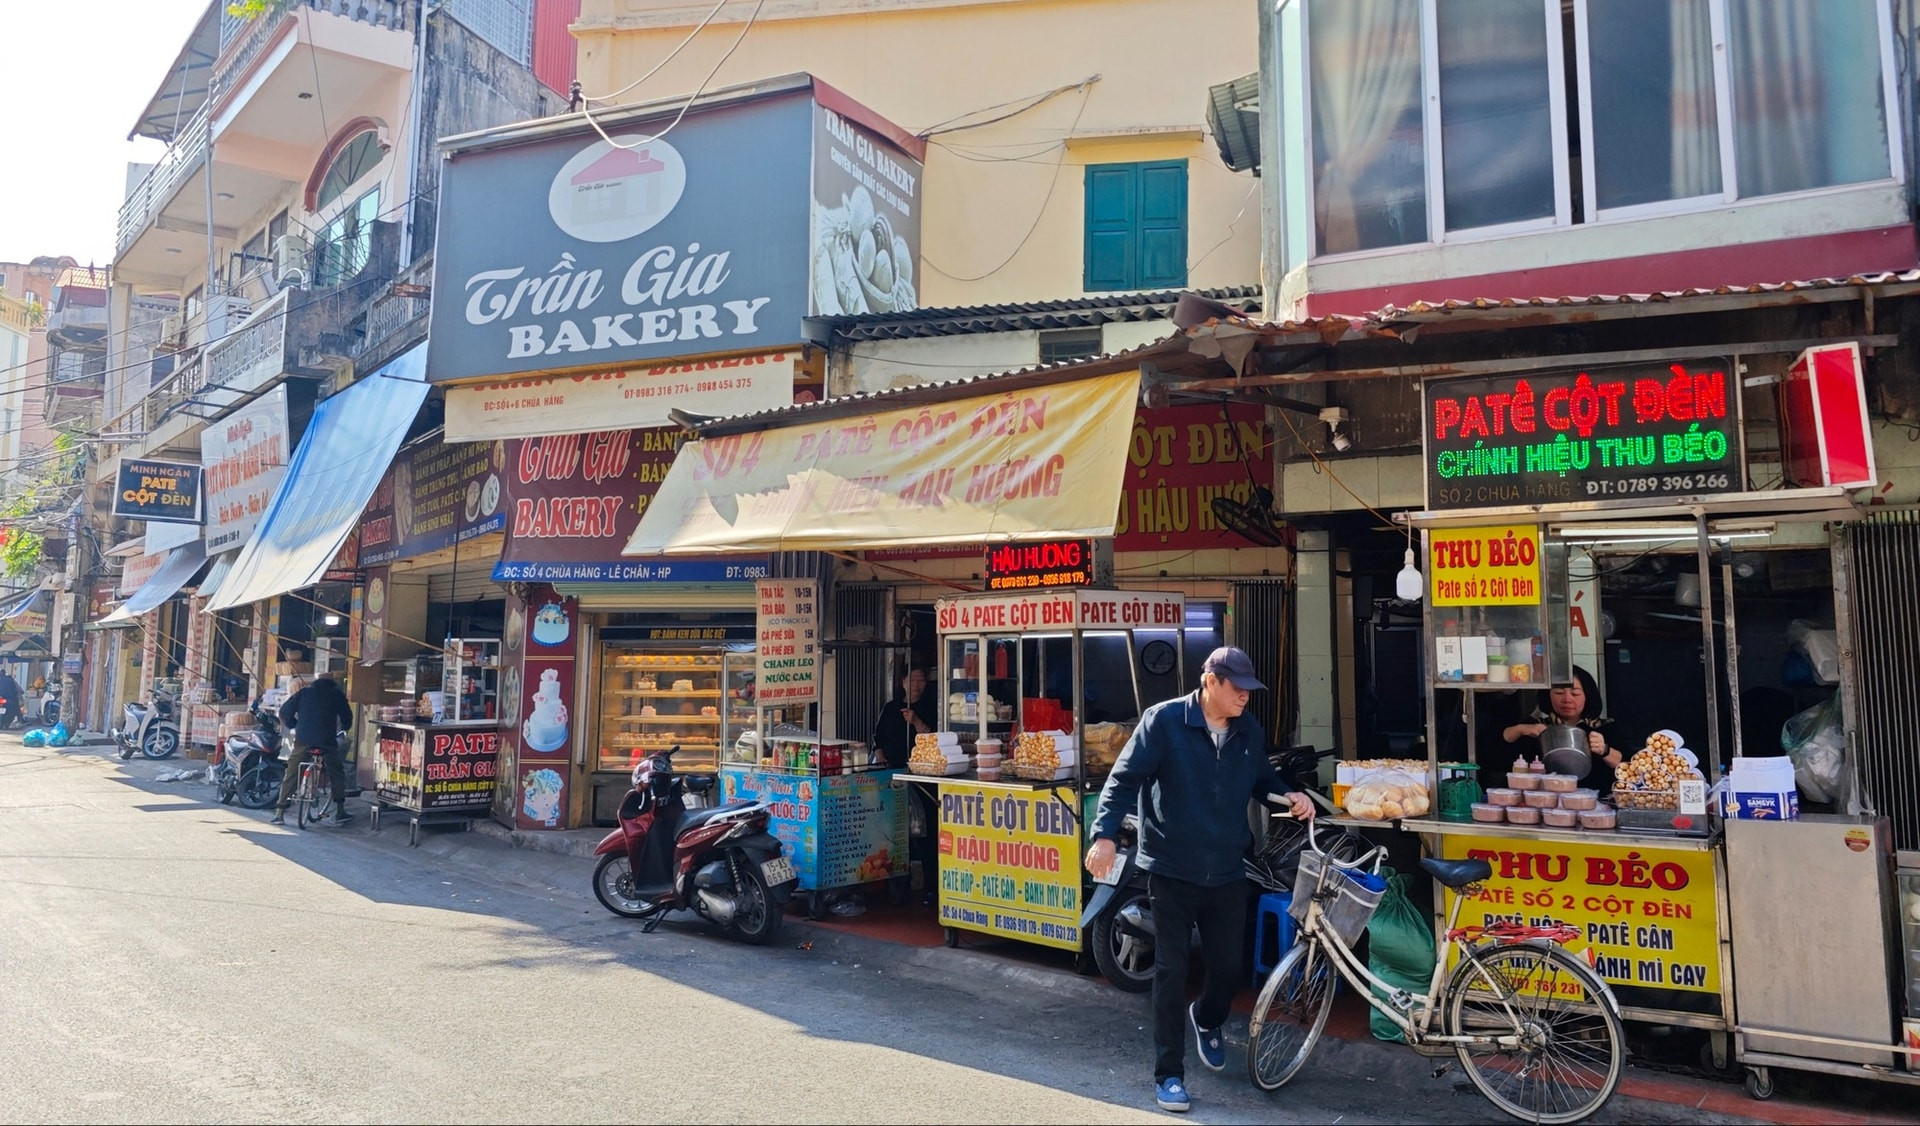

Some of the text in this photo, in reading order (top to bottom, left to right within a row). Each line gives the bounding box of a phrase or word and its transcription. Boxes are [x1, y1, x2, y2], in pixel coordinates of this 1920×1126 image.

[857, 134, 875, 168] GIA
[877, 149, 915, 197] BAKERY
[465, 243, 731, 325] Trần Gia
[507, 297, 771, 359] BAKERY
[658, 385, 672, 397] 316
[719, 379, 733, 390] 454
[736, 378, 752, 388] 375
[1435, 363, 1726, 439] PATÊ CỘT ĐÈN
[1187, 410, 1265, 464] ĐÈN
[1437, 422, 1728, 479] CHÍNH HIỆU THU BÉO
[130, 465, 157, 475] MINH
[141, 476, 176, 490] PATE
[963, 453, 1065, 504] HƯƠNG
[123, 488, 191, 506] CỘT ĐÈN
[1463, 487, 1472, 502] 2
[1585, 480, 1614, 495] ĐT:
[1617, 475, 1657, 493] 0789
[1662, 473, 1694, 491] 396
[1695, 473, 1729, 489] 266
[513, 496, 623, 538] BAKERY
[1137, 478, 1190, 542] HẬU
[992, 545, 1021, 574] HẬU
[1434, 530, 1536, 568] THU BÉO
[503, 567, 521, 578] ĐC:
[522, 562, 537, 578] SỐ
[537, 568, 544, 578] 4
[545, 564, 573, 578] CHÙA
[573, 563, 601, 578] HÀNG
[608, 564, 622, 578] LÊ
[623, 563, 650, 579] CHÂN
[657, 568, 671, 578] HP
[726, 566, 742, 578] ĐT:
[1438, 574, 1533, 601] Pate số 2 Cột Đèn
[940, 596, 1073, 630] SỐ 4 PATE CỘT ĐÈN
[1081, 597, 1181, 627] PATE CỘT ĐÈN
[804, 629, 814, 639] 15K
[804, 644, 814, 654] 15K
[763, 658, 814, 669] CHANH LEO
[765, 672, 812, 684] NƯỚC CAM
[434, 733, 498, 755] PATE
[427, 756, 471, 780] TRẦN
[442, 781, 448, 792] 6
[943, 791, 1075, 836] PATÊ CỘT ĐÈN
[957, 835, 991, 865] HẬU
[996, 841, 1060, 872] HƯƠNG
[1585, 852, 1690, 891] BÉO
[1024, 878, 1044, 906] BÁNH
[1062, 886, 1076, 910] CAY
[1522, 888, 1554, 907] SỐ
[1562, 895, 1575, 909] 2
[1584, 895, 1634, 918] CỘT
[1642, 895, 1692, 919] ĐÈN
[1003, 916, 1017, 931] 0936
[1017, 918, 1027, 932] 918
[1028, 920, 1037, 935] 179
[1041, 922, 1054, 938] 0979
[1056, 924, 1066, 940] 631
[1587, 922, 1674, 950] PATÊ CÂN
[1597, 954, 1706, 987] ÁNH MÌ CAY
